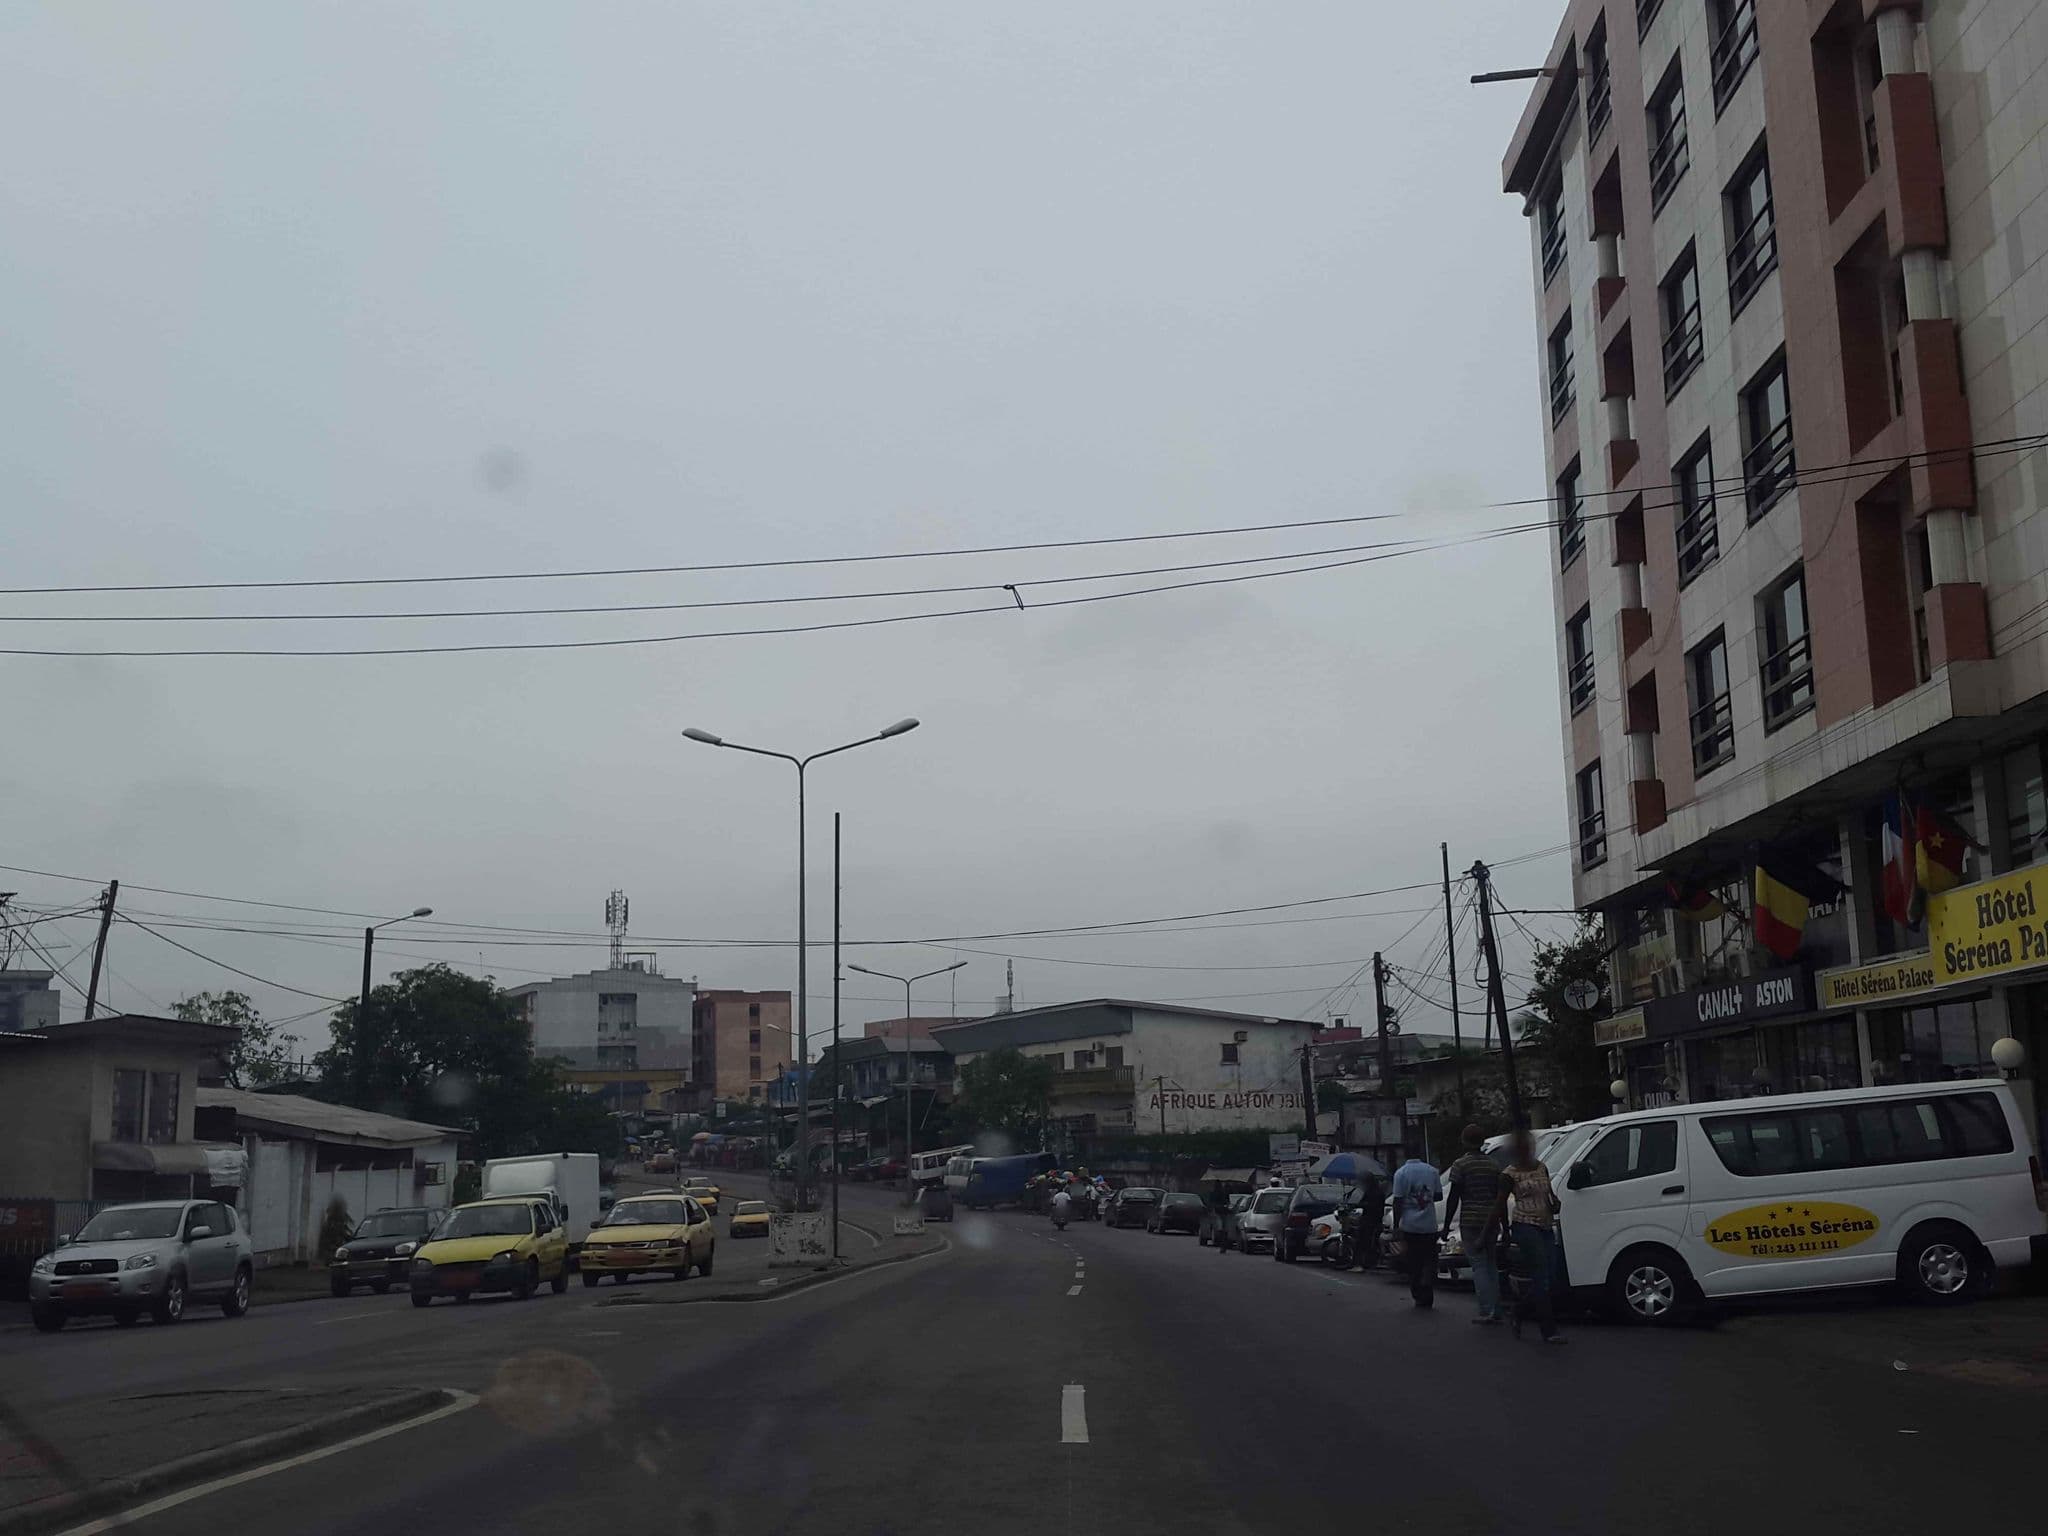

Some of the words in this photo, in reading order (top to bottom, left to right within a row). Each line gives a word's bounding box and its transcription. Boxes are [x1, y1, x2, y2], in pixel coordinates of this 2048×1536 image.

[1976, 880, 2036, 928] Hôtel
[1945, 933, 2012, 974] Séréna
[1833, 978, 1860, 999] Hôtel
[1861, 970, 1896, 995] Séréna
[1898, 968, 1934, 990] Palace
[1697, 985, 1742, 1022] CANAL+
[1756, 977, 1794, 1007] ASTON
[1150, 1094, 1216, 1110] AFRIQUE
[1710, 1229, 1741, 1243] Les
[1745, 1223, 1806, 1241] Hôtels
[1810, 1218, 1874, 1236] Séréna
[1776, 1243, 1795, 1254] 243
[1799, 1242, 1816, 1252] 111
[1820, 1240, 1839, 1250] 111
